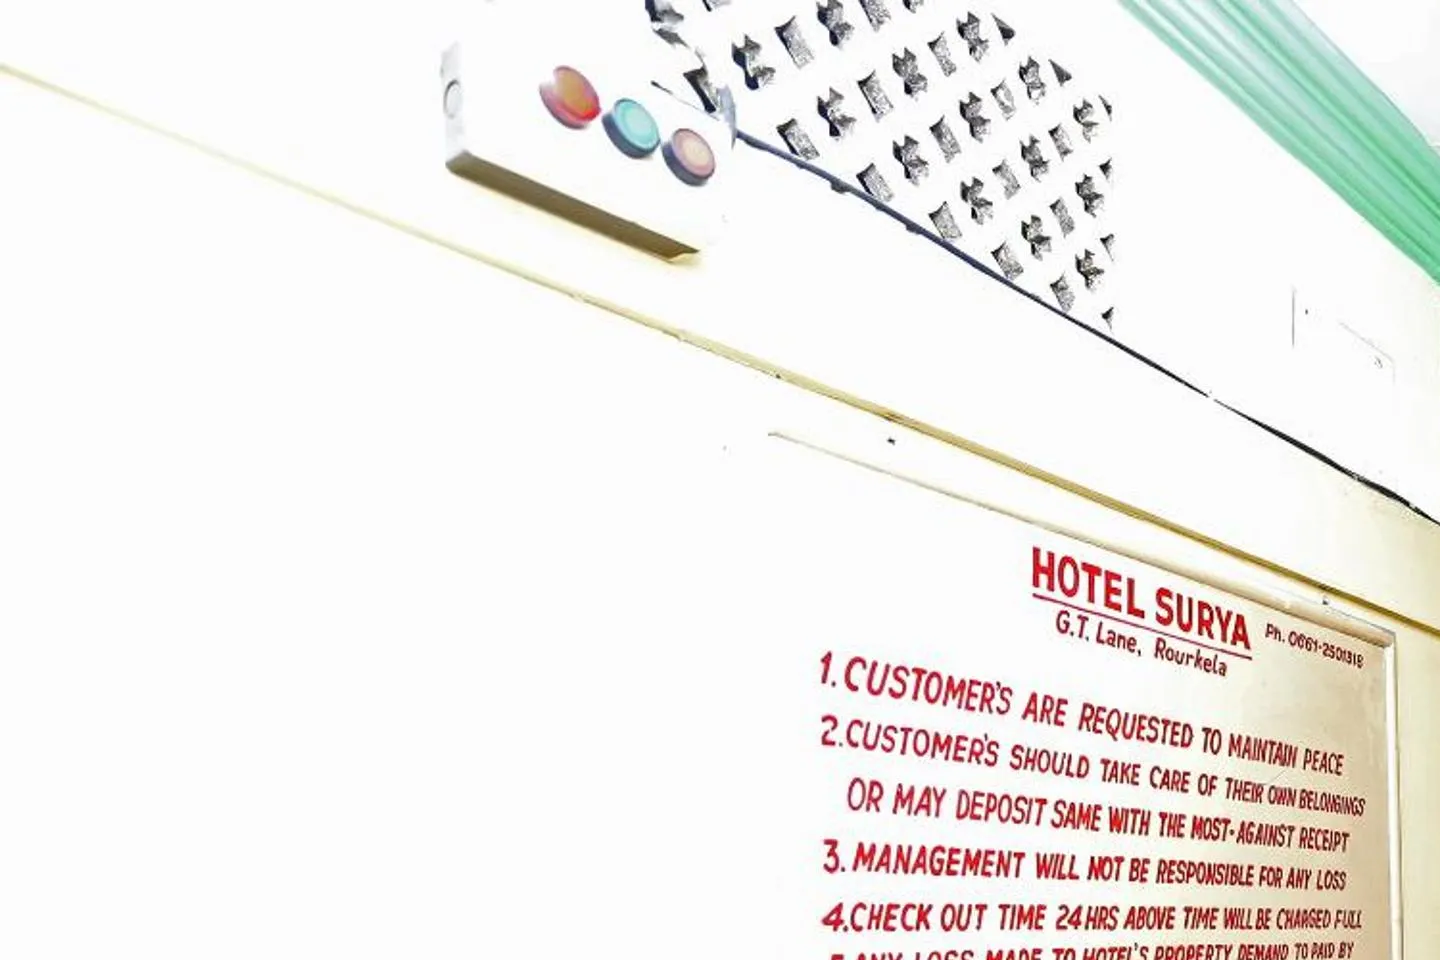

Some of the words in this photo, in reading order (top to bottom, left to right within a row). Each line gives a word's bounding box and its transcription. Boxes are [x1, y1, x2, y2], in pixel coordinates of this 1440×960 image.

[1031, 545, 1147, 619] HOTEL
[1154, 586, 1252, 650] SURYA
[1095, 620, 1142, 658] Lane,
[1154, 636, 1228, 678] Rourkela
[1264, 622, 1286, 643] Ph.
[843, 655, 1013, 716] CUSTOMER'S
[1021, 690, 1069, 728] ARE
[1077, 702, 1195, 750] REQUESTED
[1201, 727, 1223, 756] TO
[1227, 733, 1299, 769] MAINTAIN
[1302, 748, 1345, 777] PEACE
[1009, 743, 1091, 780] SHOULD
[1099, 757, 1141, 787] TAKE
[1148, 765, 1191, 794] CARE
[1197, 773, 1219, 797] OF
[1225, 777, 1265, 804] THEIR
[1267, 785, 1297, 807] OWN
[1298, 788, 1366, 818] BELONGINGS
[846, 776, 885, 813] OR
[892, 783, 947, 817] MAY
[955, 789, 1048, 827] DEPOSIT
[1050, 799, 1103, 832] SAME
[1107, 806, 1153, 837] WITH
[1157, 810, 1187, 838] THE
[1298, 826, 1350, 853] RECEIPT
[851, 841, 1028, 879] MANAGEMENT
[1034, 852, 1081, 881] WILL
[1086, 855, 1126, 882] NOT
[1128, 857, 1151, 885] BE
[1155, 859, 1255, 889] RESPONSIBLE
[1257, 864, 1284, 890] FOR
[1285, 868, 1312, 891] ANY
[1315, 869, 1348, 892] LOSS
[939, 902, 988, 933] OUT
[997, 902, 1048, 932] TIME
[1123, 905, 1176, 931] ABOVE
[1183, 906, 1220, 930] TIME
[1222, 907, 1253, 931] WILL
[1254, 908, 1272, 931] BE
[1333, 909, 1363, 930] FULL
[1293, 942, 1309, 960] TO
[1310, 942, 1335, 960] PAID
[1337, 941, 1355, 959] BY
